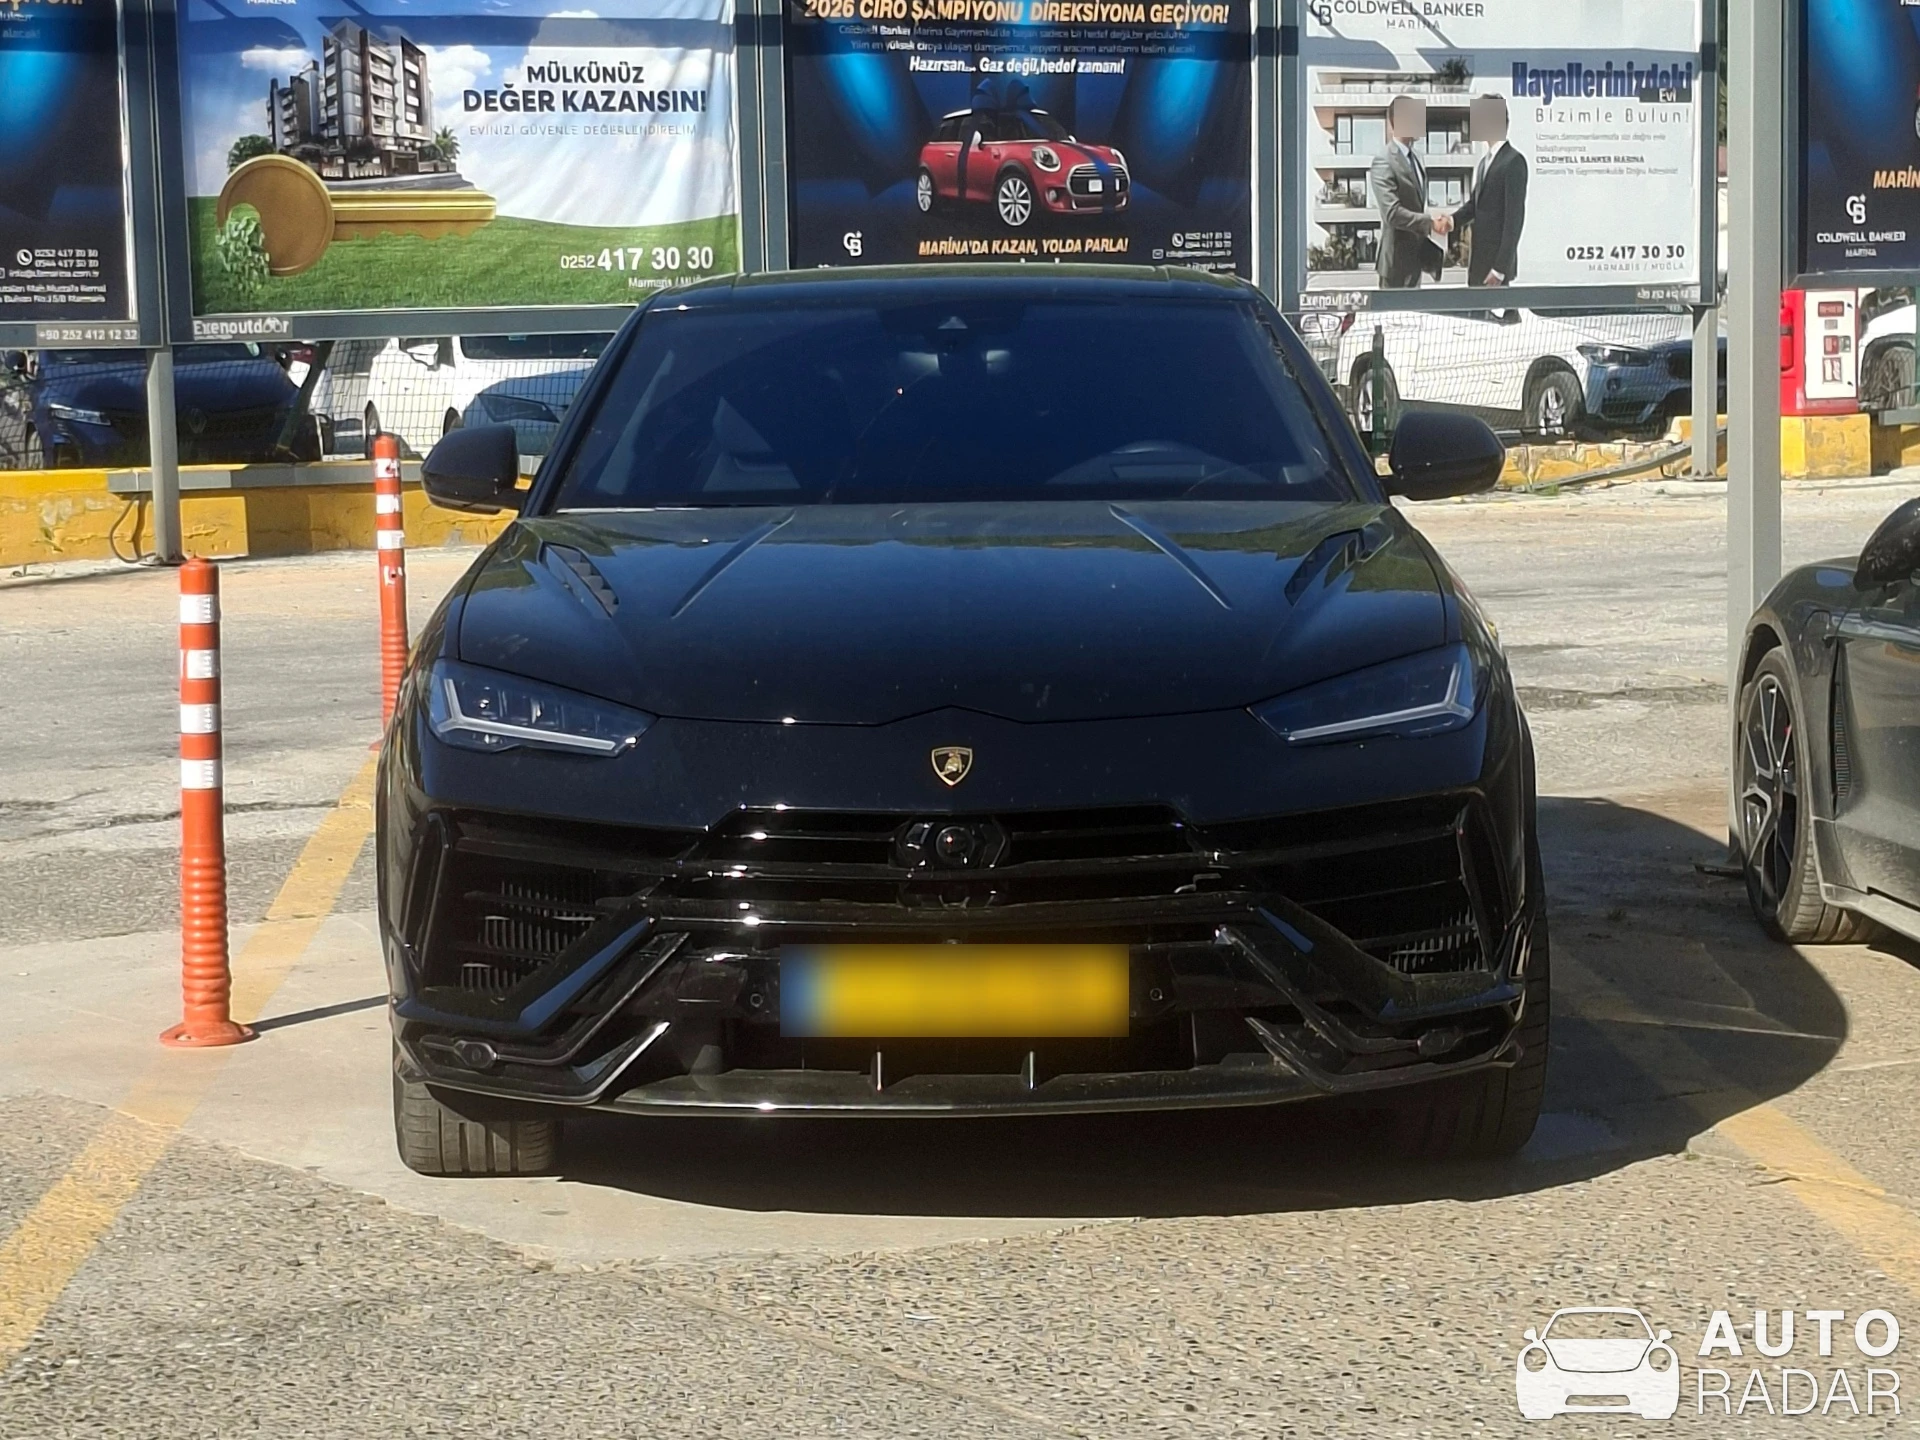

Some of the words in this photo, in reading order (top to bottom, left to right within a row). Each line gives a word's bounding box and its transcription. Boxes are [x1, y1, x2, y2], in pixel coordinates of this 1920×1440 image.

[804, 0, 855, 18] 2026
[1029, 2, 1146, 22] DİREKSİYONA
[1149, 1, 1230, 30] GEÇİYOR!
[1334, 0, 1418, 16] COLDWELL
[1423, 2, 1485, 17] BANKER
[527, 61, 645, 84] MÜLKÜNÜZ
[979, 57, 1004, 72] Gaz
[1512, 61, 1693, 105] Hayallerinizdeki
[463, 83, 556, 112] DEĞER
[562, 90, 707, 112] KAZANSIN!
[1659, 88, 1677, 103] Evi
[1536, 108, 1613, 123] Bizimle
[1625, 108, 1690, 124] Bulun!
[520, 123, 579, 136] GÜVENLE
[1816, 232, 1866, 243] COLDWELL
[919, 236, 988, 256] MARİNA'DA
[992, 239, 1038, 256] KAZAN,
[1042, 239, 1081, 253] YOLDA
[1084, 237, 1129, 253] PARLA!
[1566, 247, 1604, 260] 0252
[1610, 246, 1636, 259] 417
[1642, 245, 1660, 258] 30
[1666, 245, 1684, 258] 30
[560, 255, 595, 269] 0252
[597, 248, 643, 271] 417
[651, 247, 680, 270] 30
[687, 246, 713, 269] 30
[85, 330, 105, 340] 412
[108, 330, 121, 340] 12
